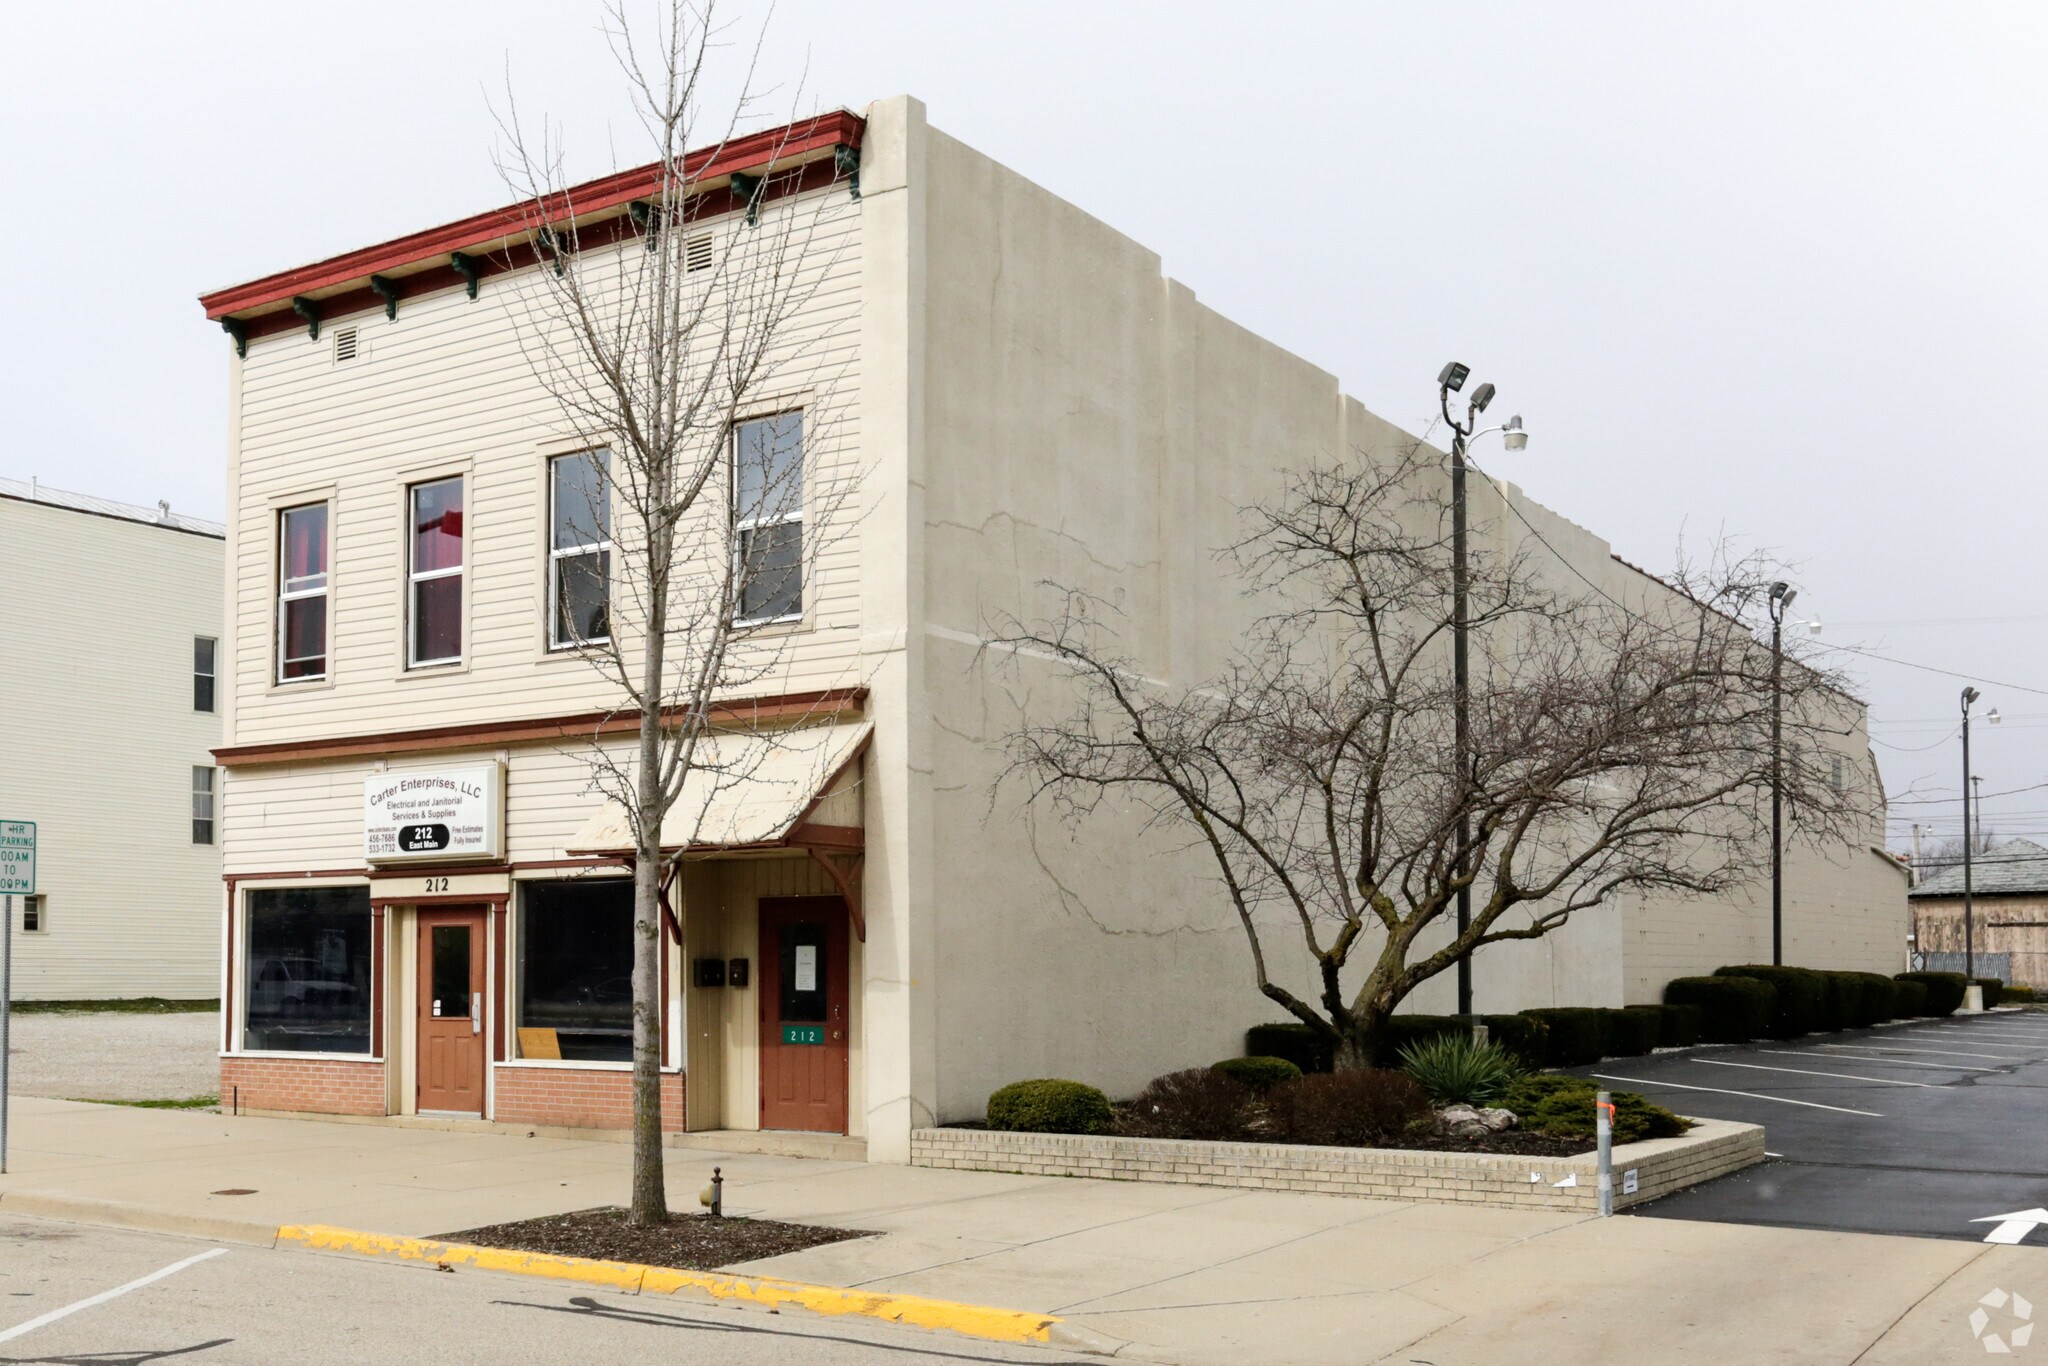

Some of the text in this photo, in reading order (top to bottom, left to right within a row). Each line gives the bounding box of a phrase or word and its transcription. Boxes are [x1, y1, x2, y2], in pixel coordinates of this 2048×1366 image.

[370, 776, 481, 806] Carter Enterprises, LLC
[387, 796, 462, 810] Electrical and Janitorial
[392, 808, 456, 821] Services & Supplies
[415, 827, 432, 840] 212
[1, 836, 33, 847] PARKING
[409, 840, 438, 850] East Main
[4, 864, 16, 875] TO
[425, 877, 449, 892] 212
[791, 1031, 815, 1041] 212
